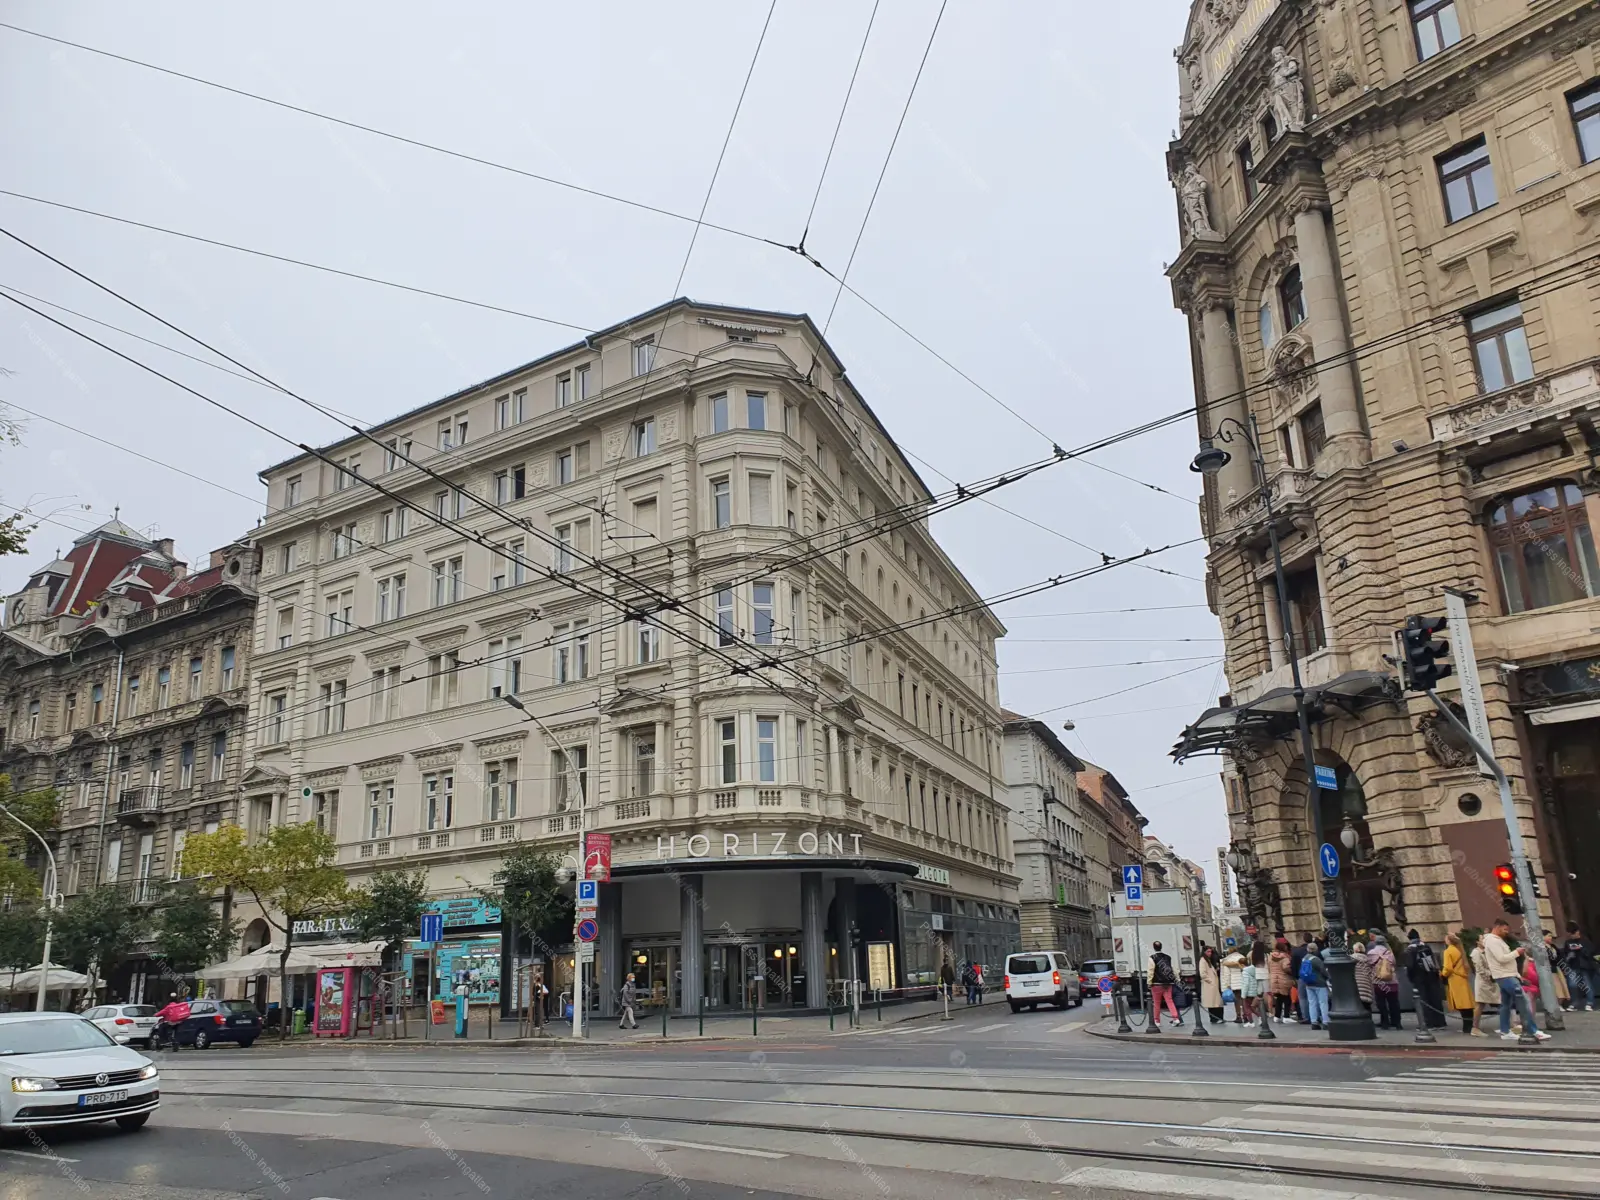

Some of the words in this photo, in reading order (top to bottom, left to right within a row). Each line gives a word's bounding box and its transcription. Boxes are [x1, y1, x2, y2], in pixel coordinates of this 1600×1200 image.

[657, 832, 863, 858] HORIZONT
[582, 884, 592, 897] P
[1129, 888, 1138, 898] P
